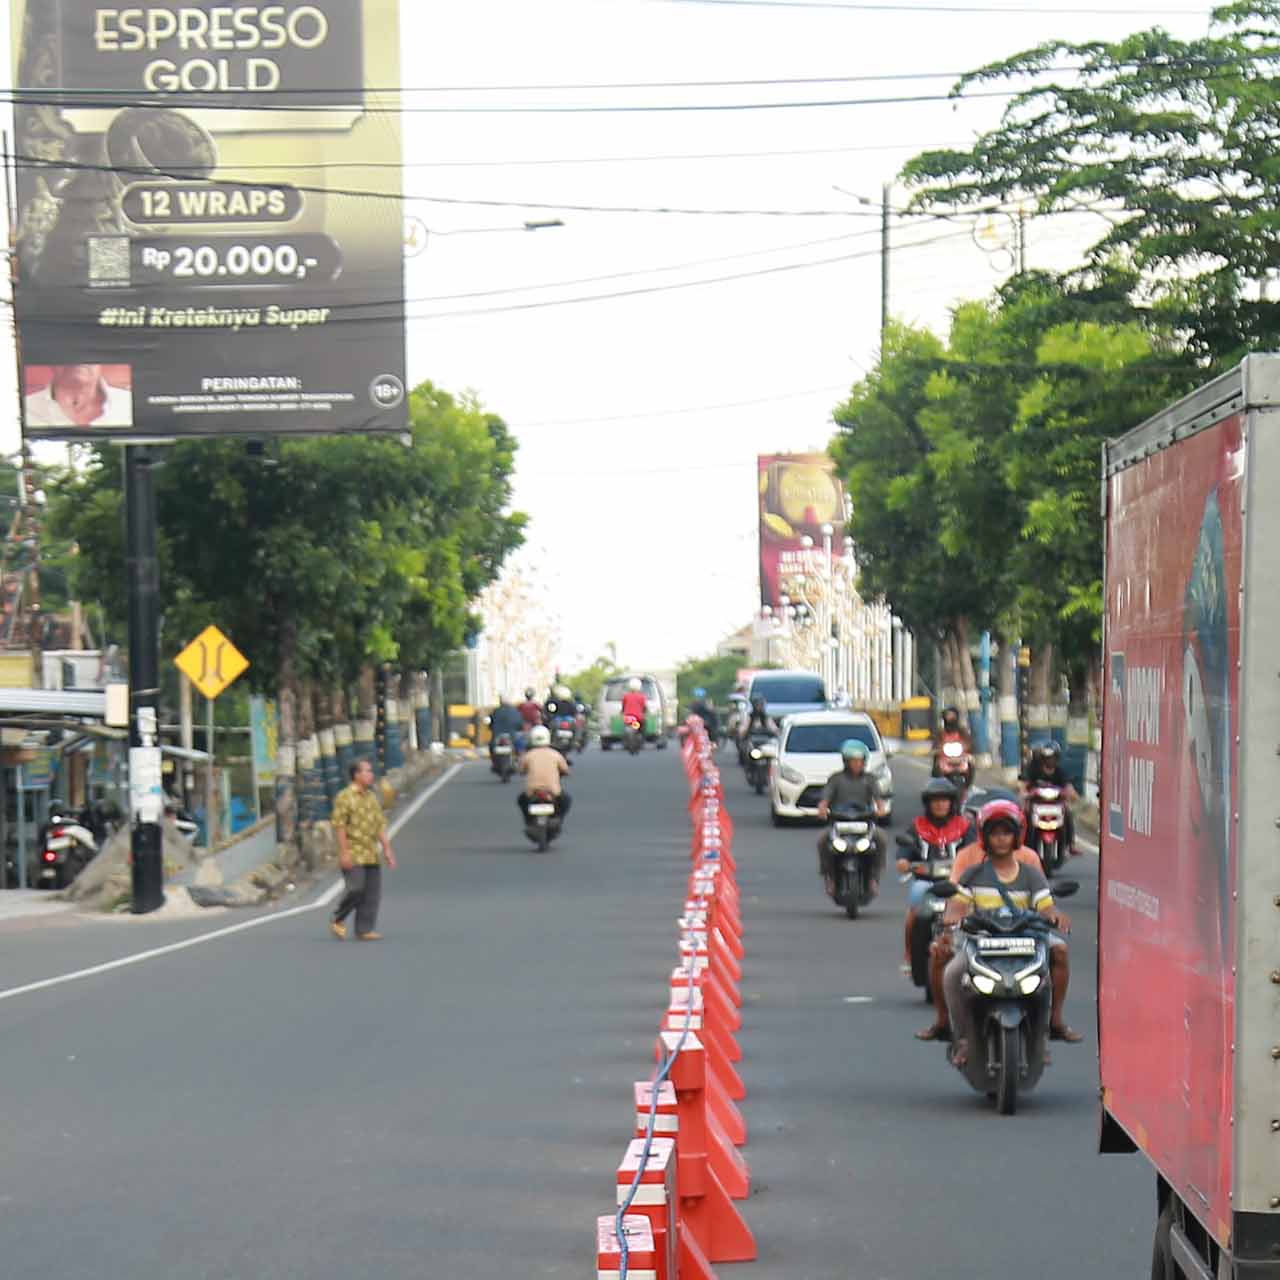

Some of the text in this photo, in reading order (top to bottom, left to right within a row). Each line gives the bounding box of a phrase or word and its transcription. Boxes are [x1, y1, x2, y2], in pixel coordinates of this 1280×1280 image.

[95, 6, 328, 50] ESPRESSO
[144, 58, 280, 95] GOLD
[140, 190, 285, 216] 12 WRAPS
[142, 245, 317, 278] Rp 20.000,-
[150, 306, 260, 331] Kreteknya
[265, 305, 330, 330] Super
[202, 377, 302, 391] PERINGATAN:
[1127, 667, 1160, 744] NIPPON
[1128, 755, 1155, 836] PAINT
